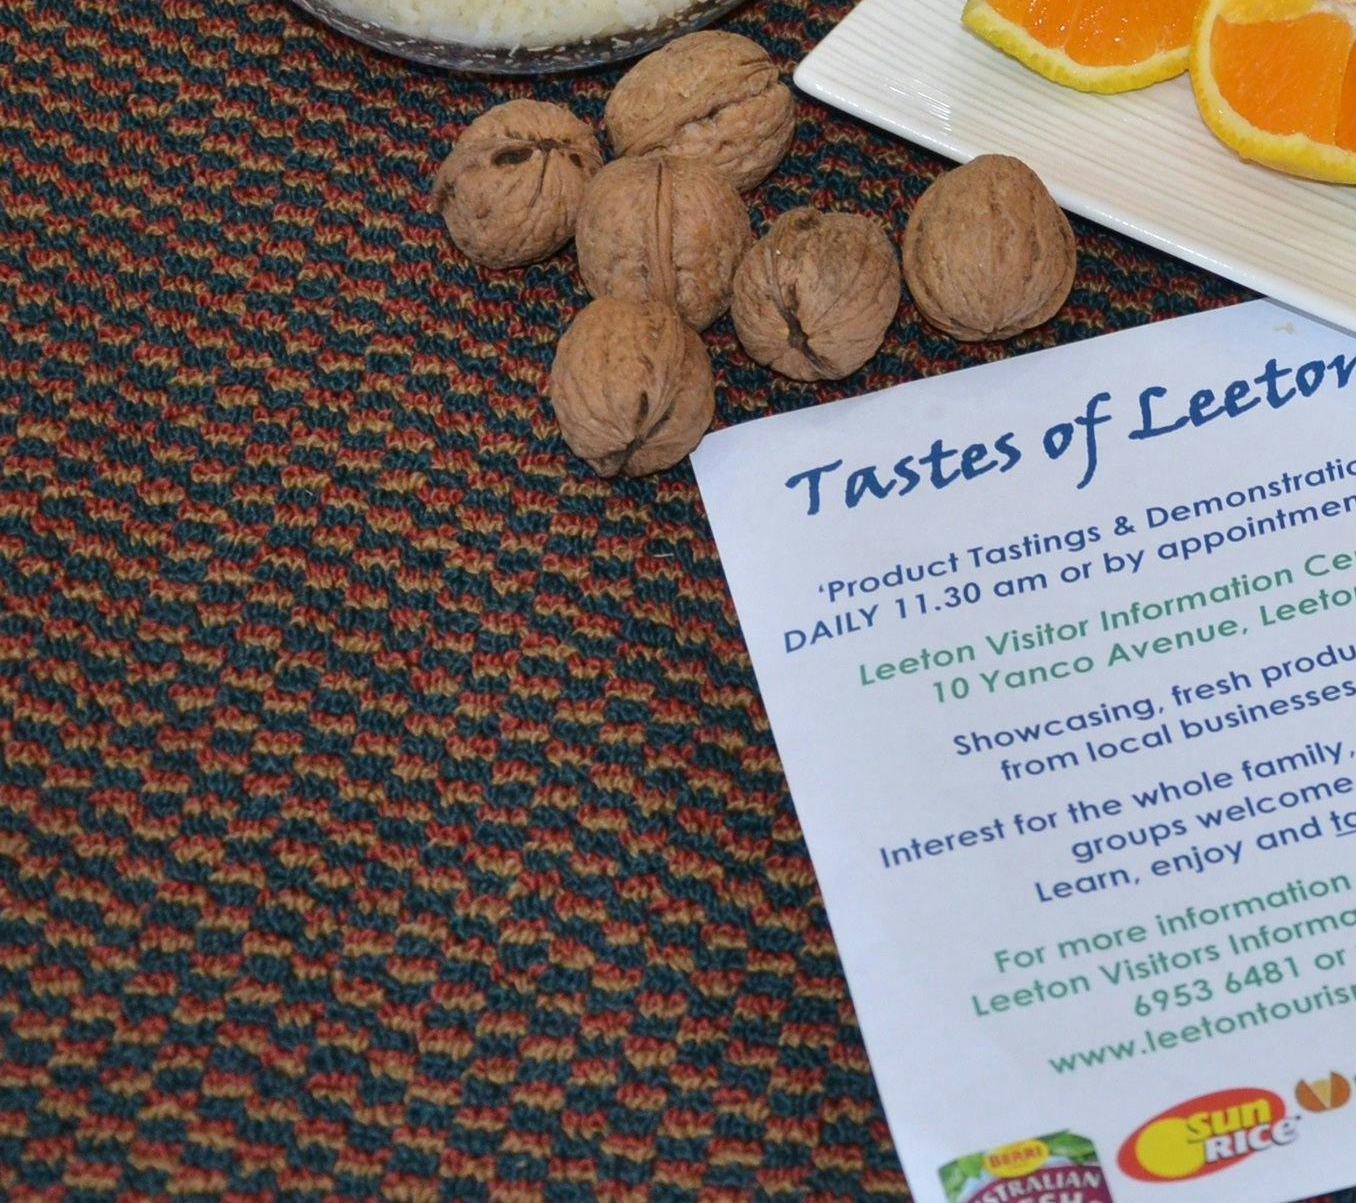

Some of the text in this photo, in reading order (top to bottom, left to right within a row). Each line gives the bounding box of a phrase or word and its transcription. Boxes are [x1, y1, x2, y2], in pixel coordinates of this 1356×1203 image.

[784, 431, 1022, 516] Tastes
[1042, 391, 1113, 490] of
[966, 525, 1102, 569] Tastings
[1113, 515, 1137, 537] &
[783, 603, 879, 654] DAILY
[894, 581, 982, 619] 11.30
[992, 573, 1048, 598] am
[1059, 561, 1093, 584] or
[1102, 549, 1145, 574] by
[859, 645, 976, 686] Leeton
[985, 619, 1089, 656] Visitor
[1100, 568, 1294, 632] Information
[932, 677, 970, 703] 10
[978, 656, 1094, 693] Yanco
[1107, 619, 1248, 667] Avenue,
[952, 697, 1164, 756] Showcasing,
[1171, 670, 1252, 707] fresh
[1000, 751, 1080, 782] from
[1085, 723, 1173, 763] local
[879, 818, 1005, 869] Interest
[1013, 811, 1058, 836] for
[1067, 799, 1123, 824] the
[1131, 770, 1234, 809] whole
[1241, 741, 1355, 782] family,
[1071, 819, 1188, 864] groups
[1034, 868, 1140, 903] Learn,
[1150, 840, 1243, 877] enjoy
[1255, 815, 1323, 851] and
[994, 946, 1045, 973] For
[1057, 925, 1147, 959] more
[1155, 874, 1352, 936] information
[971, 975, 1091, 1017] Leeton
[1098, 944, 1221, 985] Visitors
[1134, 979, 1213, 1017] 6953
[1225, 956, 1299, 994] 6481
[1314, 949, 1345, 971] or
[975, 1171, 1101, 1203] STRALIAN
